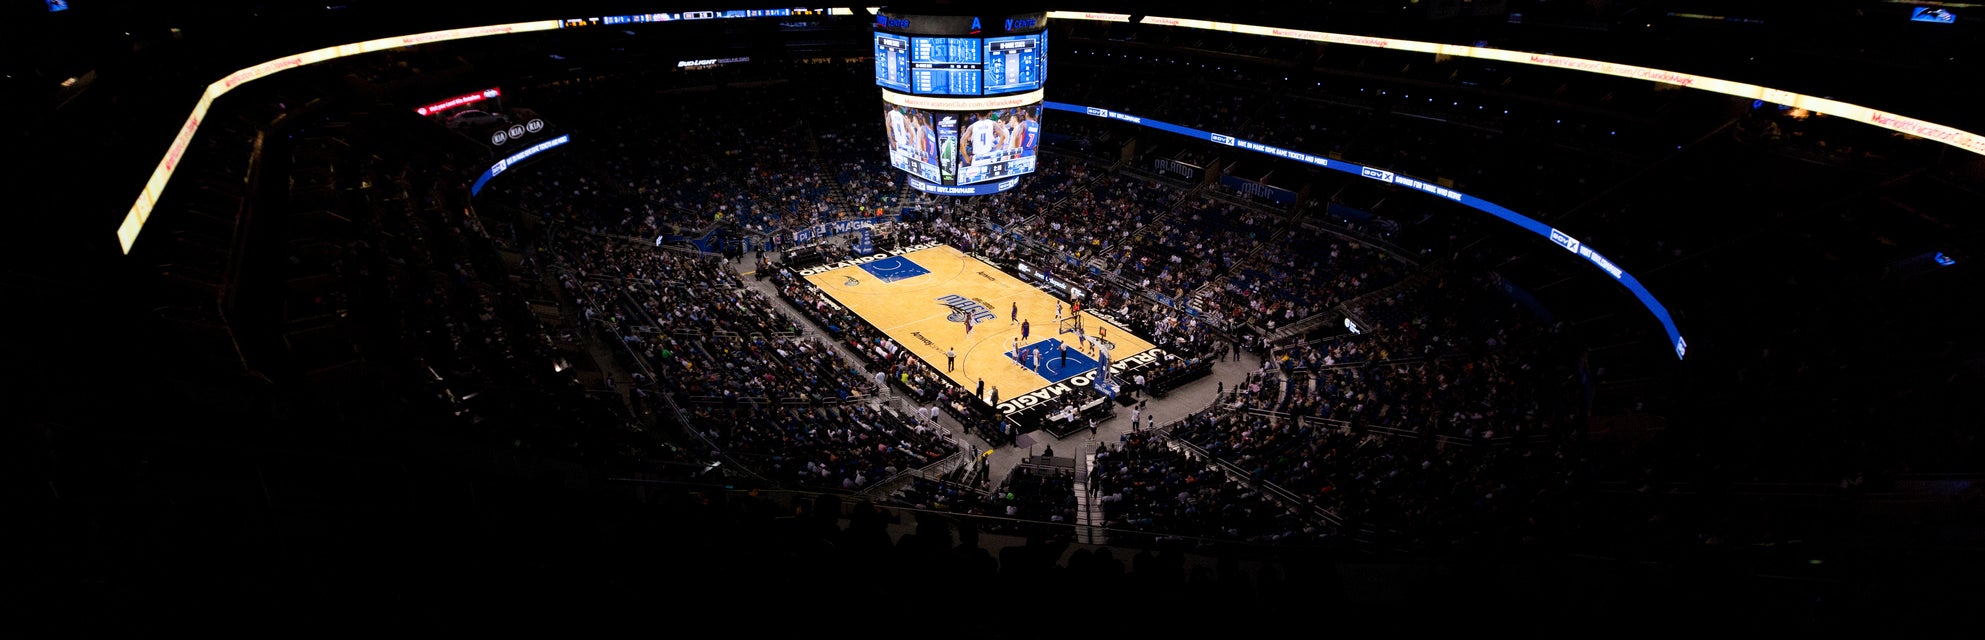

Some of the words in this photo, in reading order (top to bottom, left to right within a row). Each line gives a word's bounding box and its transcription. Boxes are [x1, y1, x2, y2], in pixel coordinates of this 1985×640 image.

[510, 126, 523, 137] KIA
[529, 121, 541, 131] KIA
[494, 133, 505, 144] KIA
[1026, 133, 1035, 147] 7
[1362, 166, 1394, 183] GOVX
[1240, 181, 1275, 200] MAGIC
[800, 252, 888, 277] ORLANDO
[891, 240, 944, 258] MAGIC
[935, 294, 998, 325] MAGIC
[996, 382, 1073, 415] MAGIC
